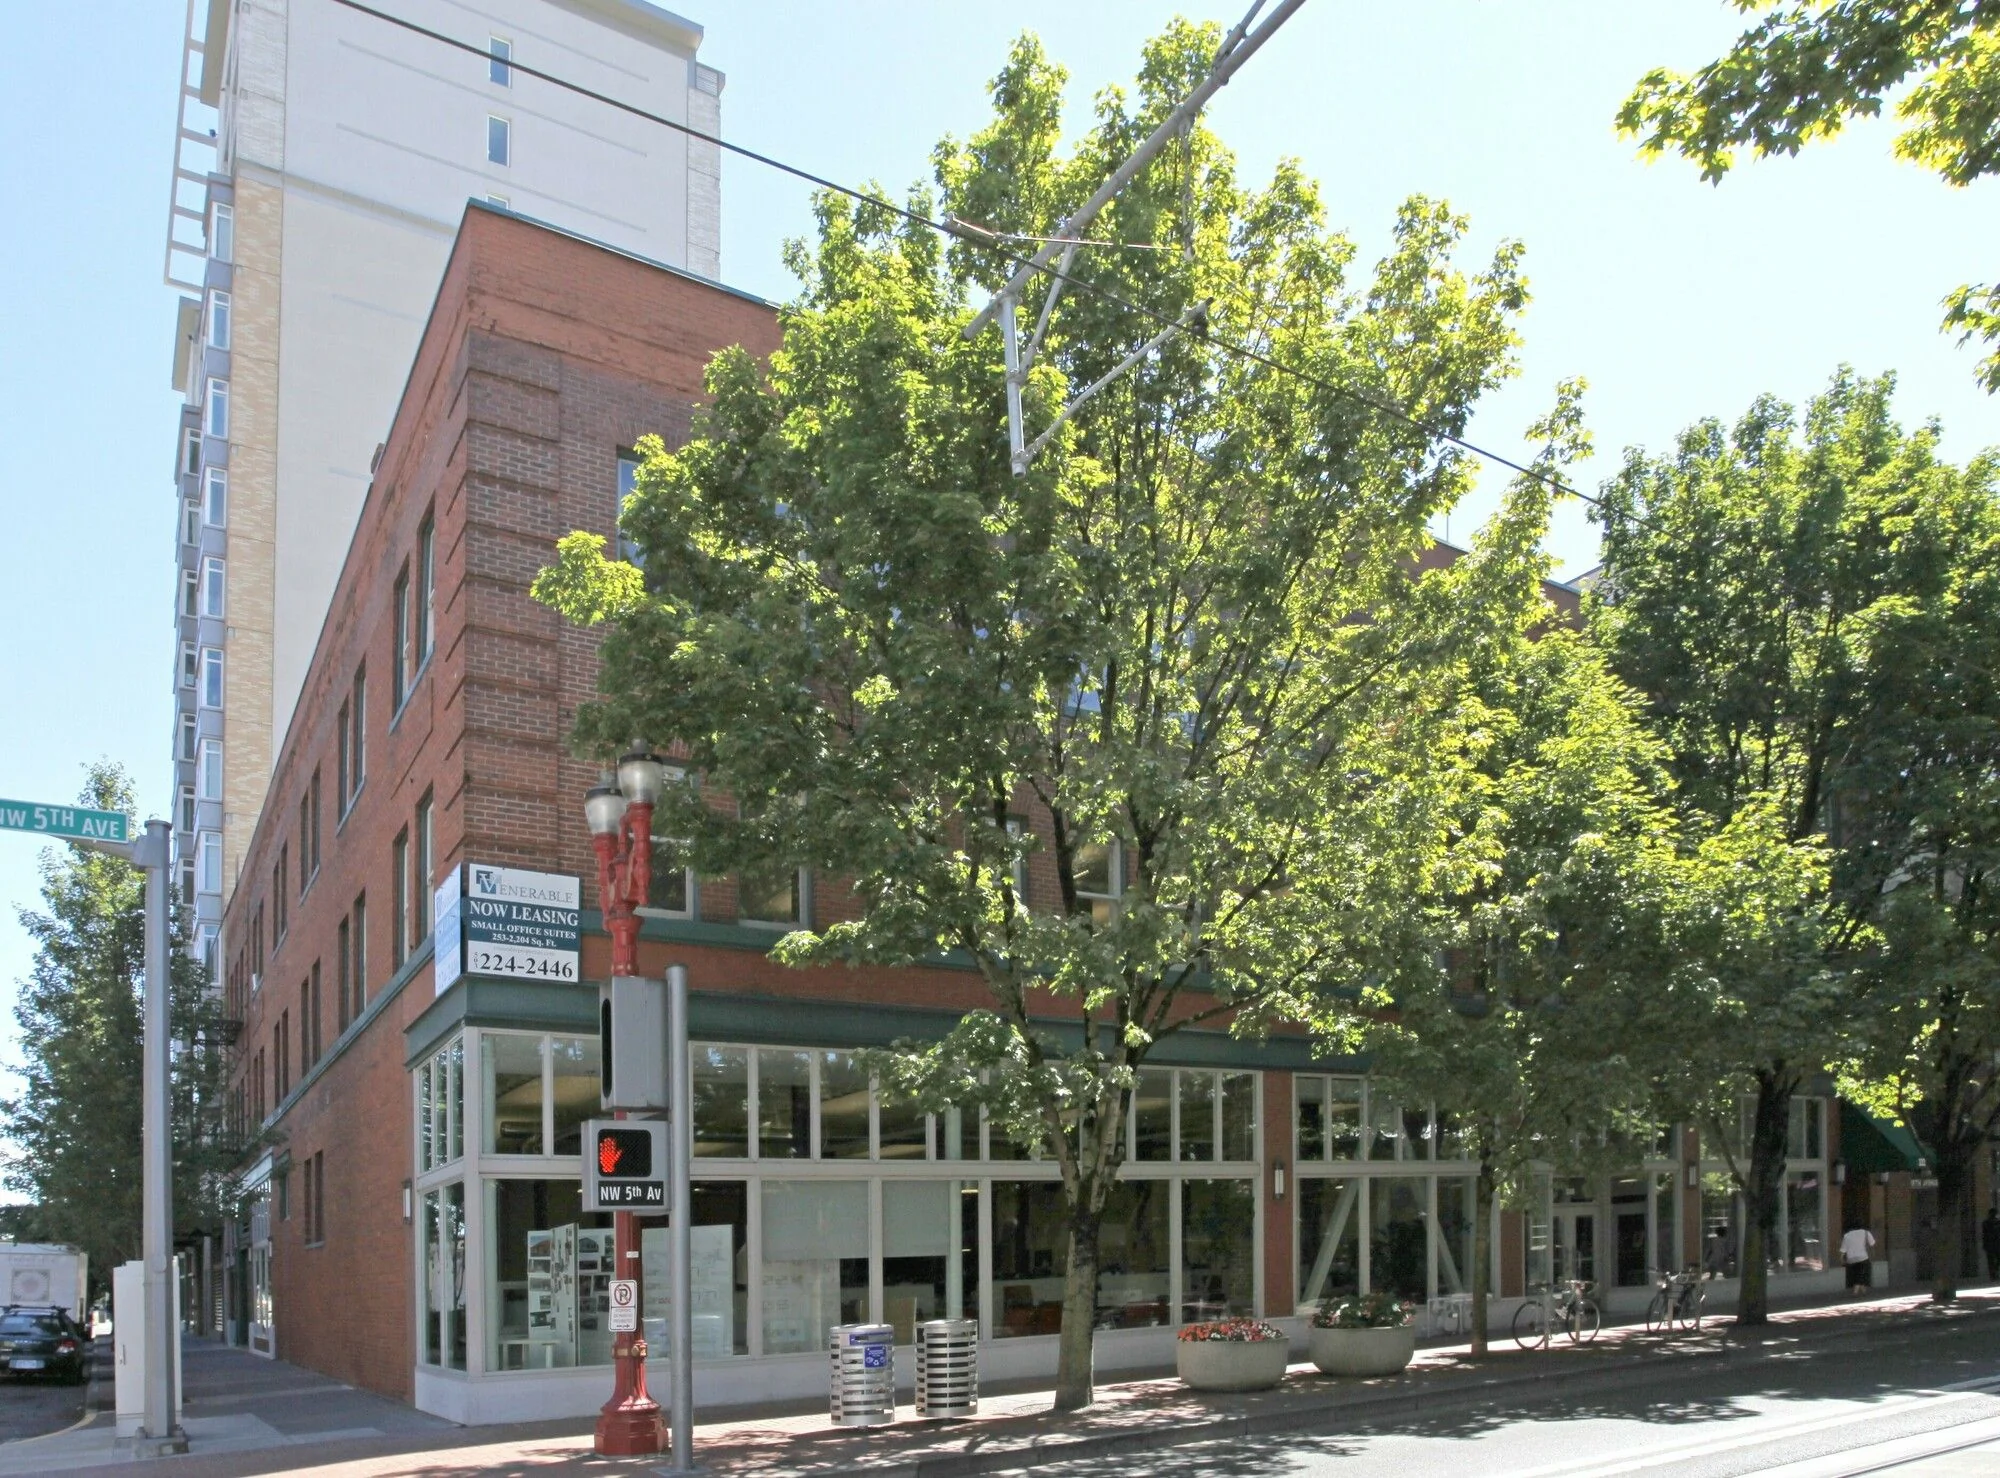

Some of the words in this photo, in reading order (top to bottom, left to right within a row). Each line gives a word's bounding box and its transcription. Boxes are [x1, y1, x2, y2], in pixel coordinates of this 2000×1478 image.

[34, 807, 74, 830] 5TH
[82, 818, 119, 838] AVE
[478, 871, 573, 903] VENERABLE
[470, 900, 508, 918] NOW
[512, 905, 578, 926] LEASING
[471, 920, 505, 931] SMALL
[506, 925, 541, 936] OFFICE
[543, 929, 576, 939] SUITES
[480, 953, 573, 978] 224-2446
[600, 1186, 620, 1200] NW
[625, 1186, 641, 1200] 5th
[647, 1186, 661, 1200] Av
